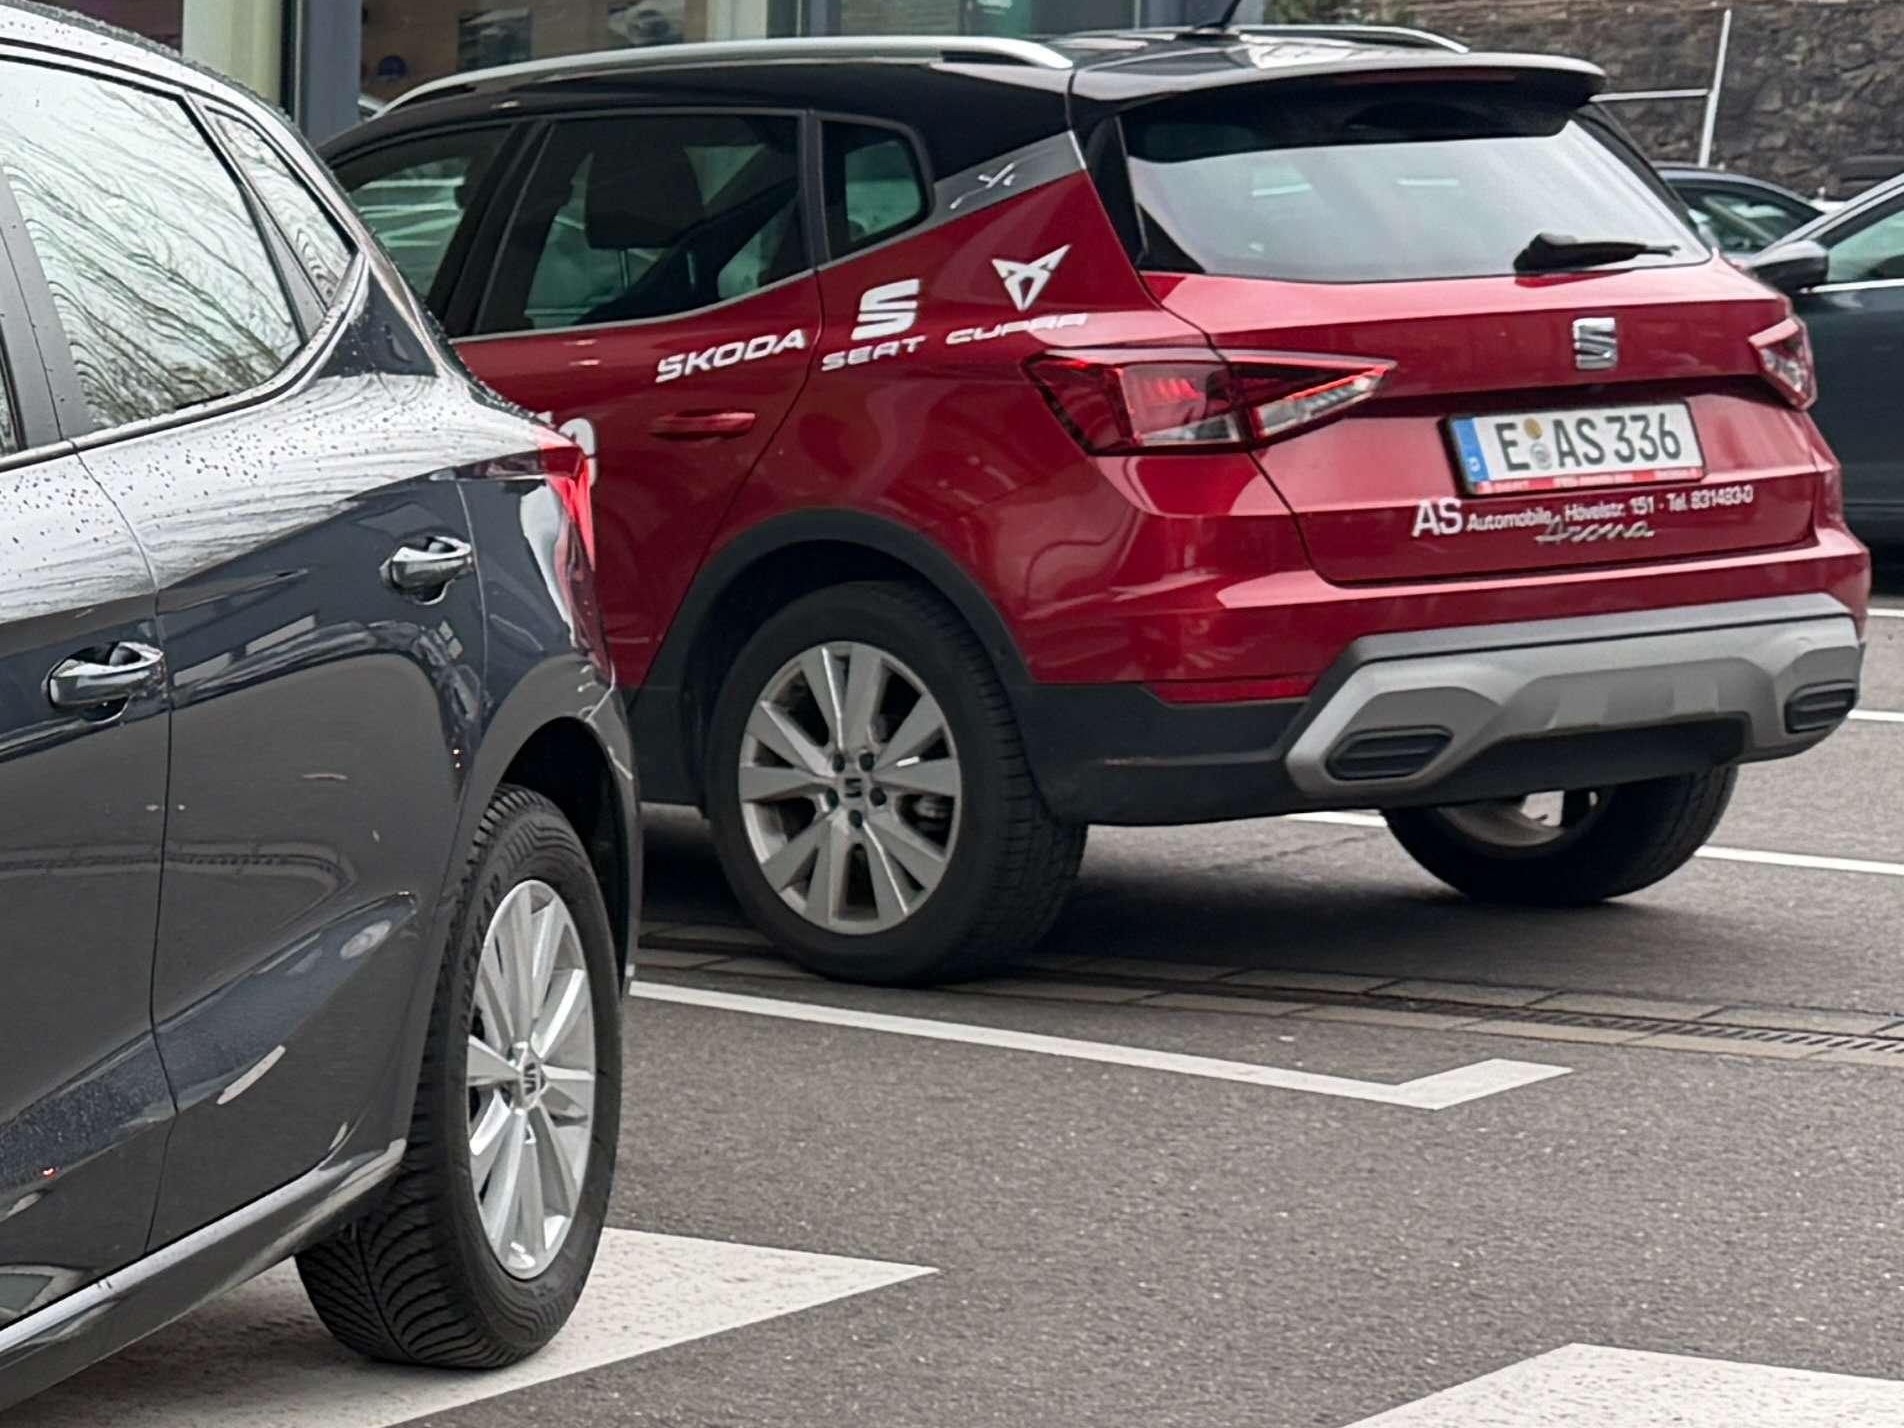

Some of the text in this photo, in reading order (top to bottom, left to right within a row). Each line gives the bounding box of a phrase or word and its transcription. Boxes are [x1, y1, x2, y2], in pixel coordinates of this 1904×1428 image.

[945, 313, 1089, 345] CUPRA
[821, 336, 926, 372] SEAT
[1411, 497, 1463, 538] AS
